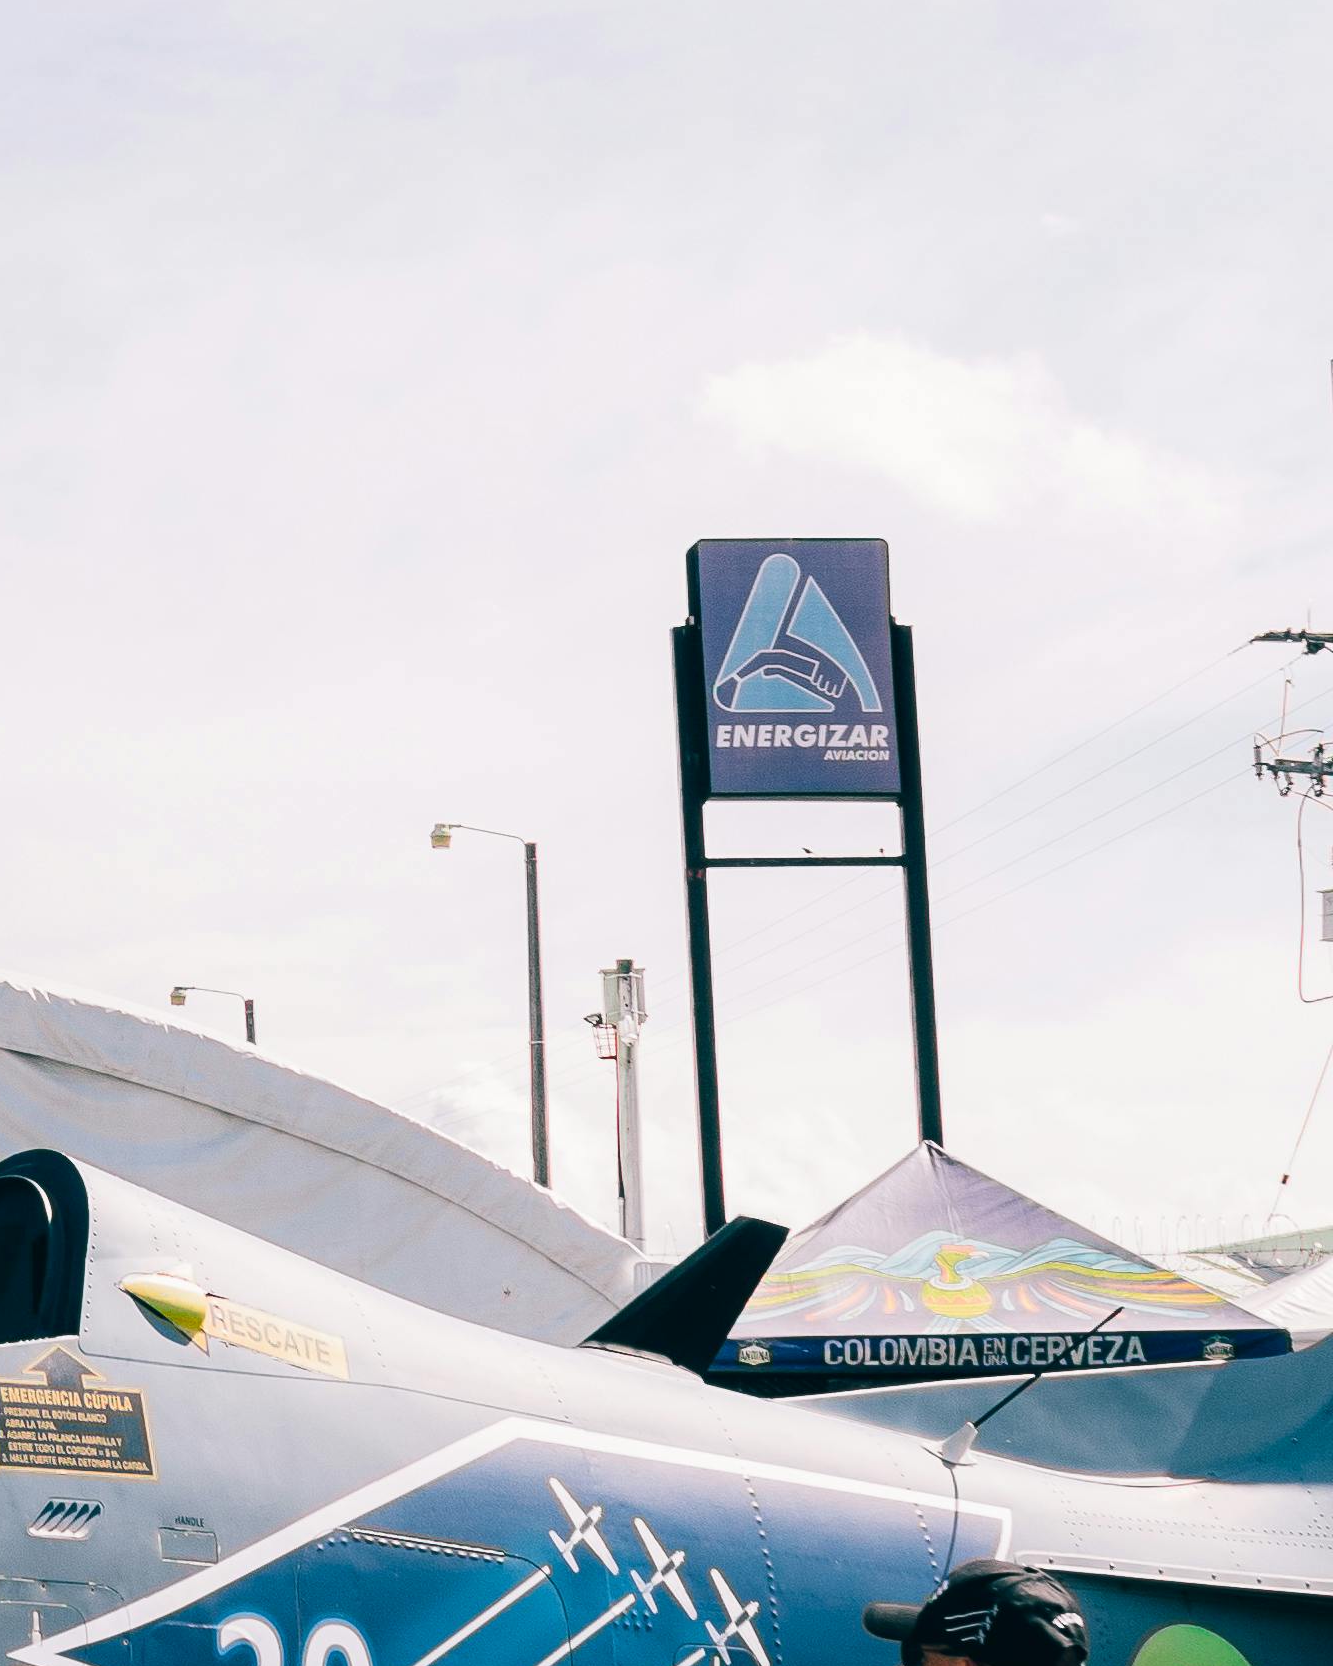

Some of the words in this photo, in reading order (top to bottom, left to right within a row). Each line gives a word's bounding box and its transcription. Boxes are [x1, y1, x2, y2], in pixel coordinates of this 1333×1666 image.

[716, 724, 889, 748] ENERGIZAR
[823, 750, 890, 761] AVIACION
[211, 1303, 333, 1366] RESCATE
[823, 1336, 979, 1367] COLOMBIA
[983, 1337, 1006, 1355] EN
[1011, 1334, 1148, 1366] CERVEZA
[983, 1354, 1009, 1367] UNA
[0, 1386, 82, 1408] EMERGENCIA
[83, 1390, 133, 1412] CÚPULA
[26, 1420, 37, 1429] LA
[37, 1432, 48, 1442] LA
